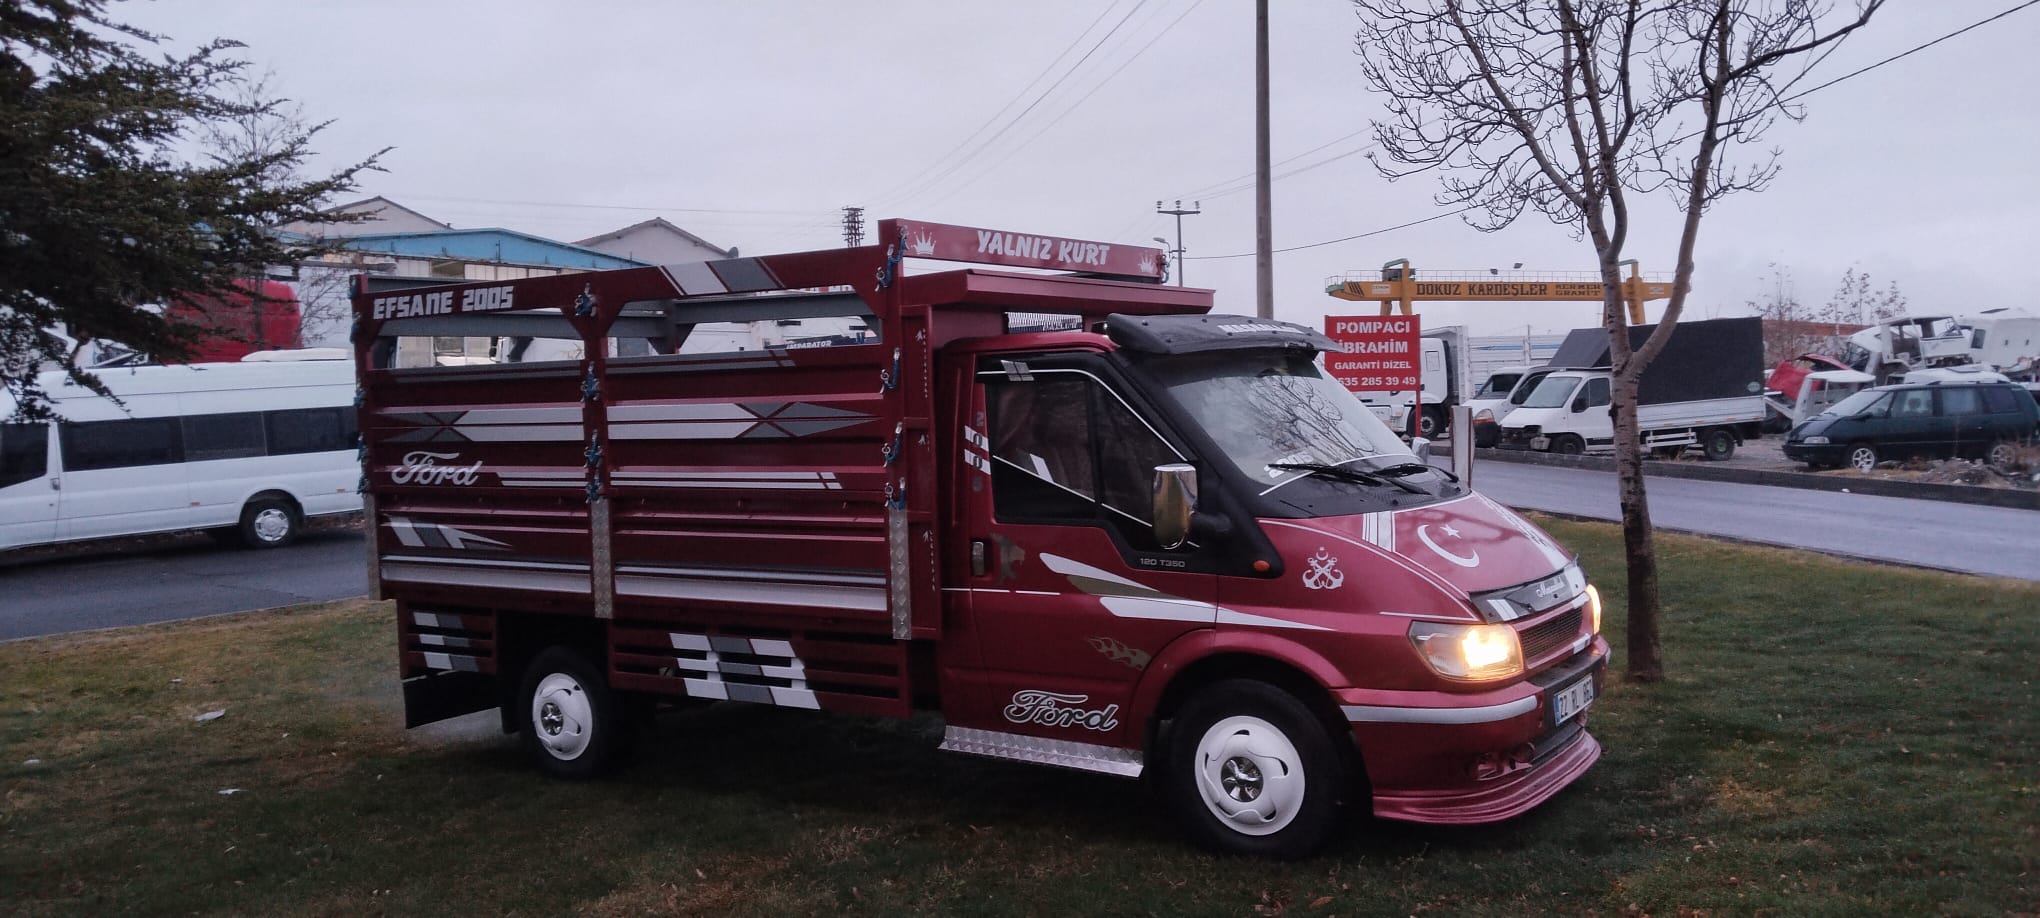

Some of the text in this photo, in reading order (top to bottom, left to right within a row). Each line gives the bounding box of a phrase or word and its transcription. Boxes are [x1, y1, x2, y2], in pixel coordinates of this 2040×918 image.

[976, 230, 1110, 265] YALNIZ KURT
[1416, 283, 1462, 296] DOKUZ
[373, 285, 514, 320] EFSANE 2005
[1336, 321, 1411, 334] POMPACI
[1339, 339, 1409, 354] İBRAHİM
[1334, 360, 1412, 370] GARANTİ DİZEL
[1361, 377, 1382, 386] 285
[1385, 376, 1399, 386] 39
[1402, 376, 1417, 385] 49
[391, 450, 483, 486] Ford
[1140, 557, 1186, 568] 120 T350
[1003, 689, 1120, 732] Ford
